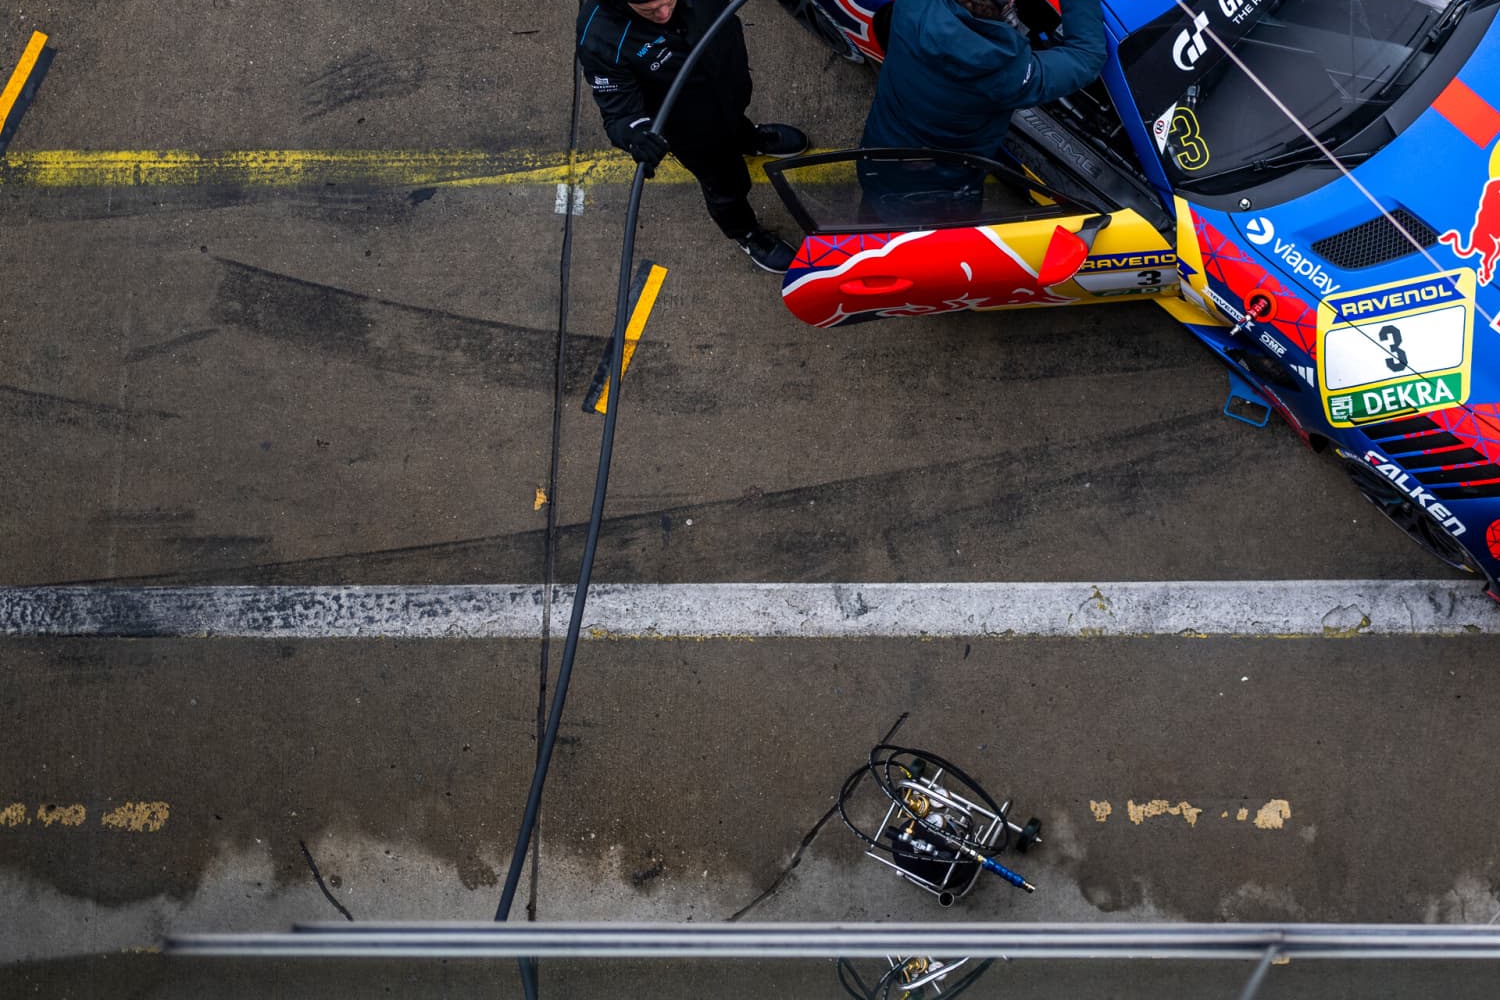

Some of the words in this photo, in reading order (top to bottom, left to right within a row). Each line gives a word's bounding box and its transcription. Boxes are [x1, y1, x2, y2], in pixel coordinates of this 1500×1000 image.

[1232, 3, 1254, 25] THE
[1171, 107, 1210, 171] 3
[1273, 238, 1341, 295] viaplay
[1340, 285, 1453, 317] RAVENOL
[1378, 324, 1409, 373] 3
[1363, 377, 1454, 415] DEKRA
[1364, 450, 1468, 537] FALKEN
